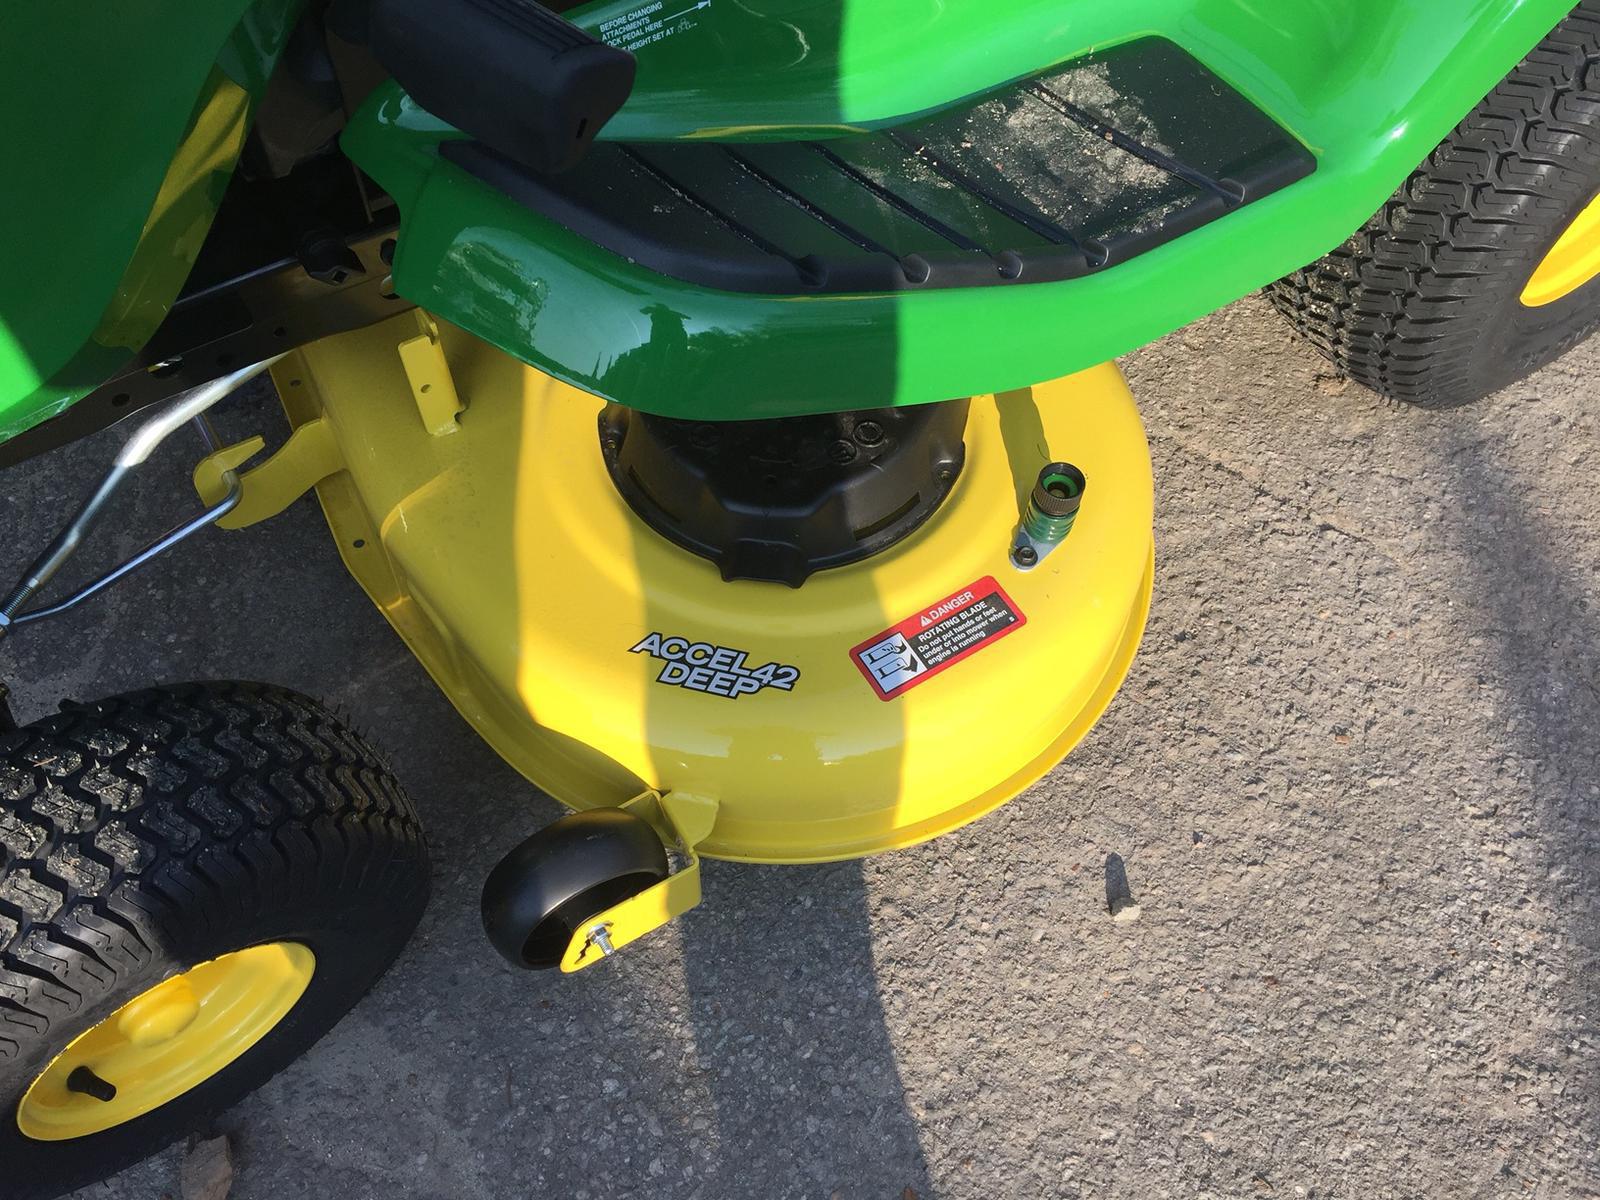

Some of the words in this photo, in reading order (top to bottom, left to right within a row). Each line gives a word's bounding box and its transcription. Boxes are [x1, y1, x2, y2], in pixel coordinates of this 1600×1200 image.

[600, 15, 627, 33] BEFORE
[627, 1, 663, 21] CHANGING
[602, 16, 650, 41] ATTACHMENTS
[605, 36, 622, 47] OCK
[622, 28, 644, 41] PEDAL
[645, 20, 663, 33] HERE
[628, 38, 651, 51] HEIGHT
[652, 31, 665, 41] SET
[666, 27, 674, 37] AT
[918, 616, 960, 642] ROTATING
[959, 601, 987, 620] BLADE
[928, 591, 974, 620] DANGER
[918, 644, 929, 653] Do
[930, 637, 942, 647] not
[942, 630, 954, 642] put
[954, 619, 975, 633] hands
[982, 606, 997, 617] feet
[923, 646, 944, 659] under
[944, 640, 952, 648] or
[951, 632, 966, 643] into
[966, 621, 989, 635] mower
[989, 609, 1008, 622] when
[628, 631, 751, 677] ACCEL
[750, 661, 801, 692] 42
[927, 649, 951, 665] engine
[951, 644, 959, 652] is
[959, 630, 986, 648] running
[656, 661, 762, 699] DEEP
